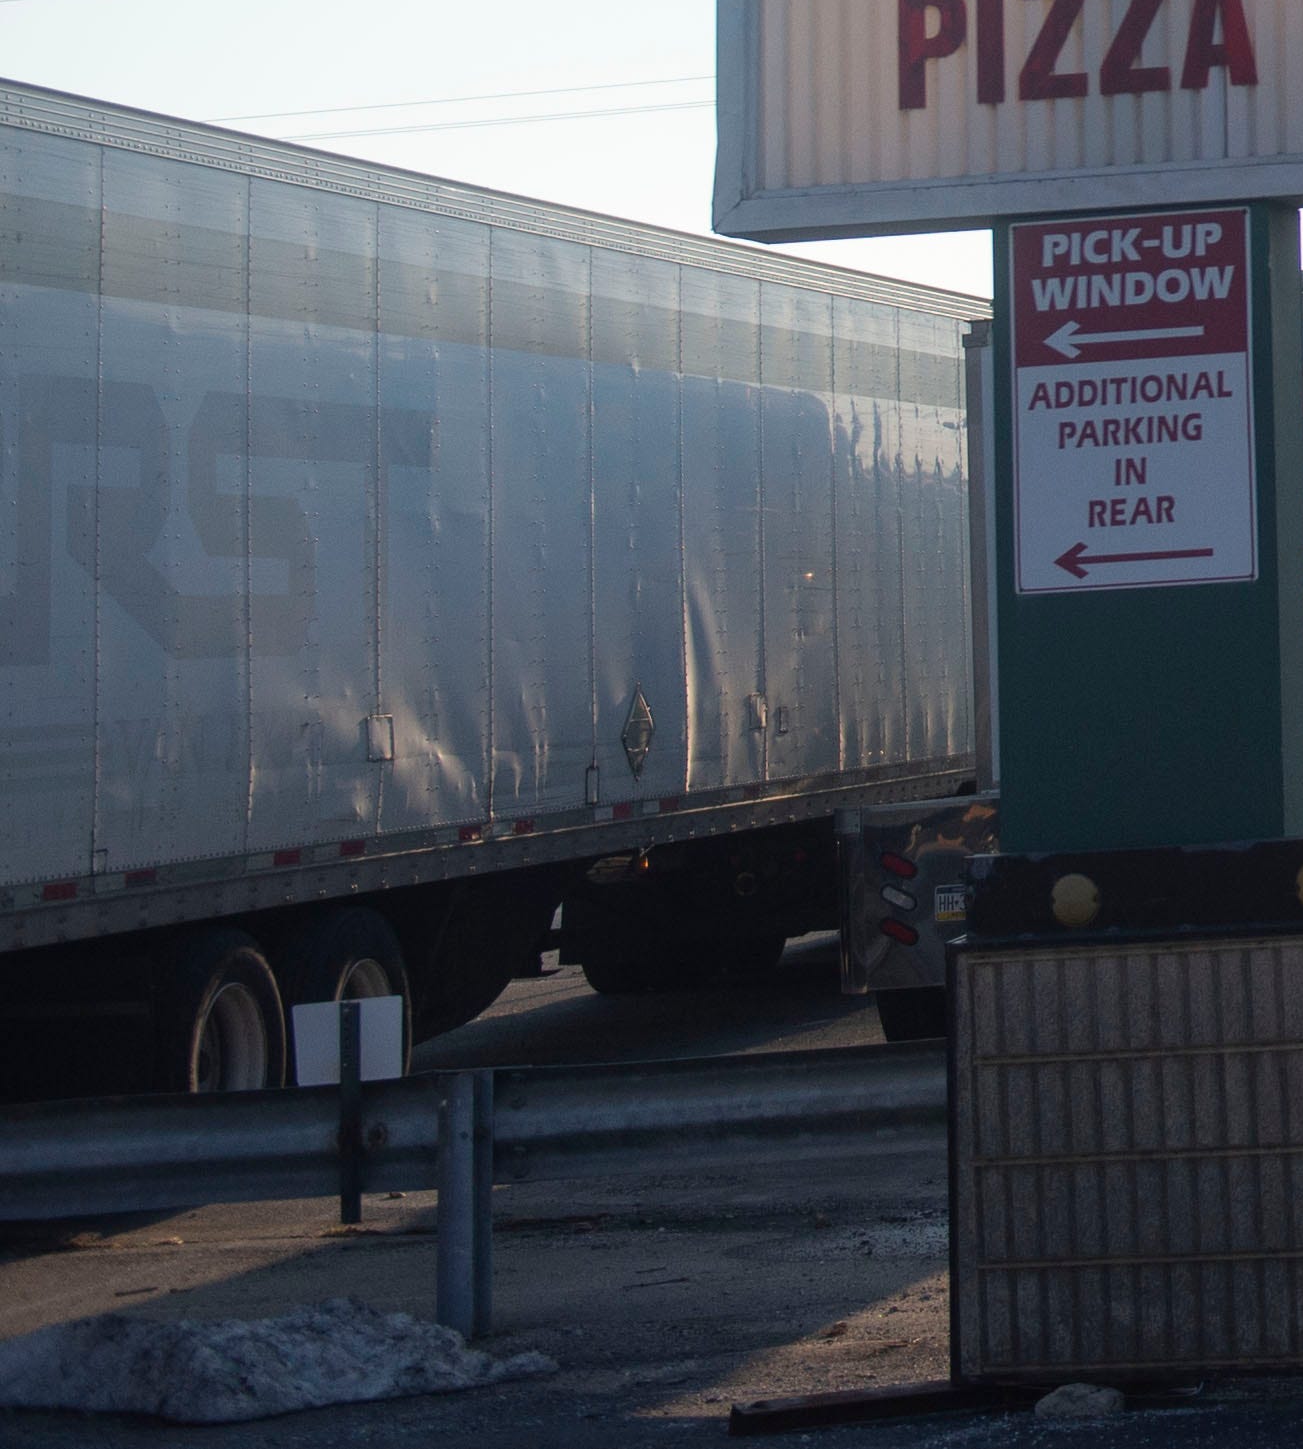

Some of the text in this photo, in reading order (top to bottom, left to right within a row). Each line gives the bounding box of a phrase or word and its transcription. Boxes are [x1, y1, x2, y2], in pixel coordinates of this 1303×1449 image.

[1042, 222, 1223, 268] PICK-UP
[1031, 265, 1235, 312] WINDOW
[1027, 370, 1233, 411] ADDITIONAL
[1058, 413, 1203, 450] PARKING
[1115, 457, 1147, 486] IN
[1088, 495, 1175, 528] REAR
